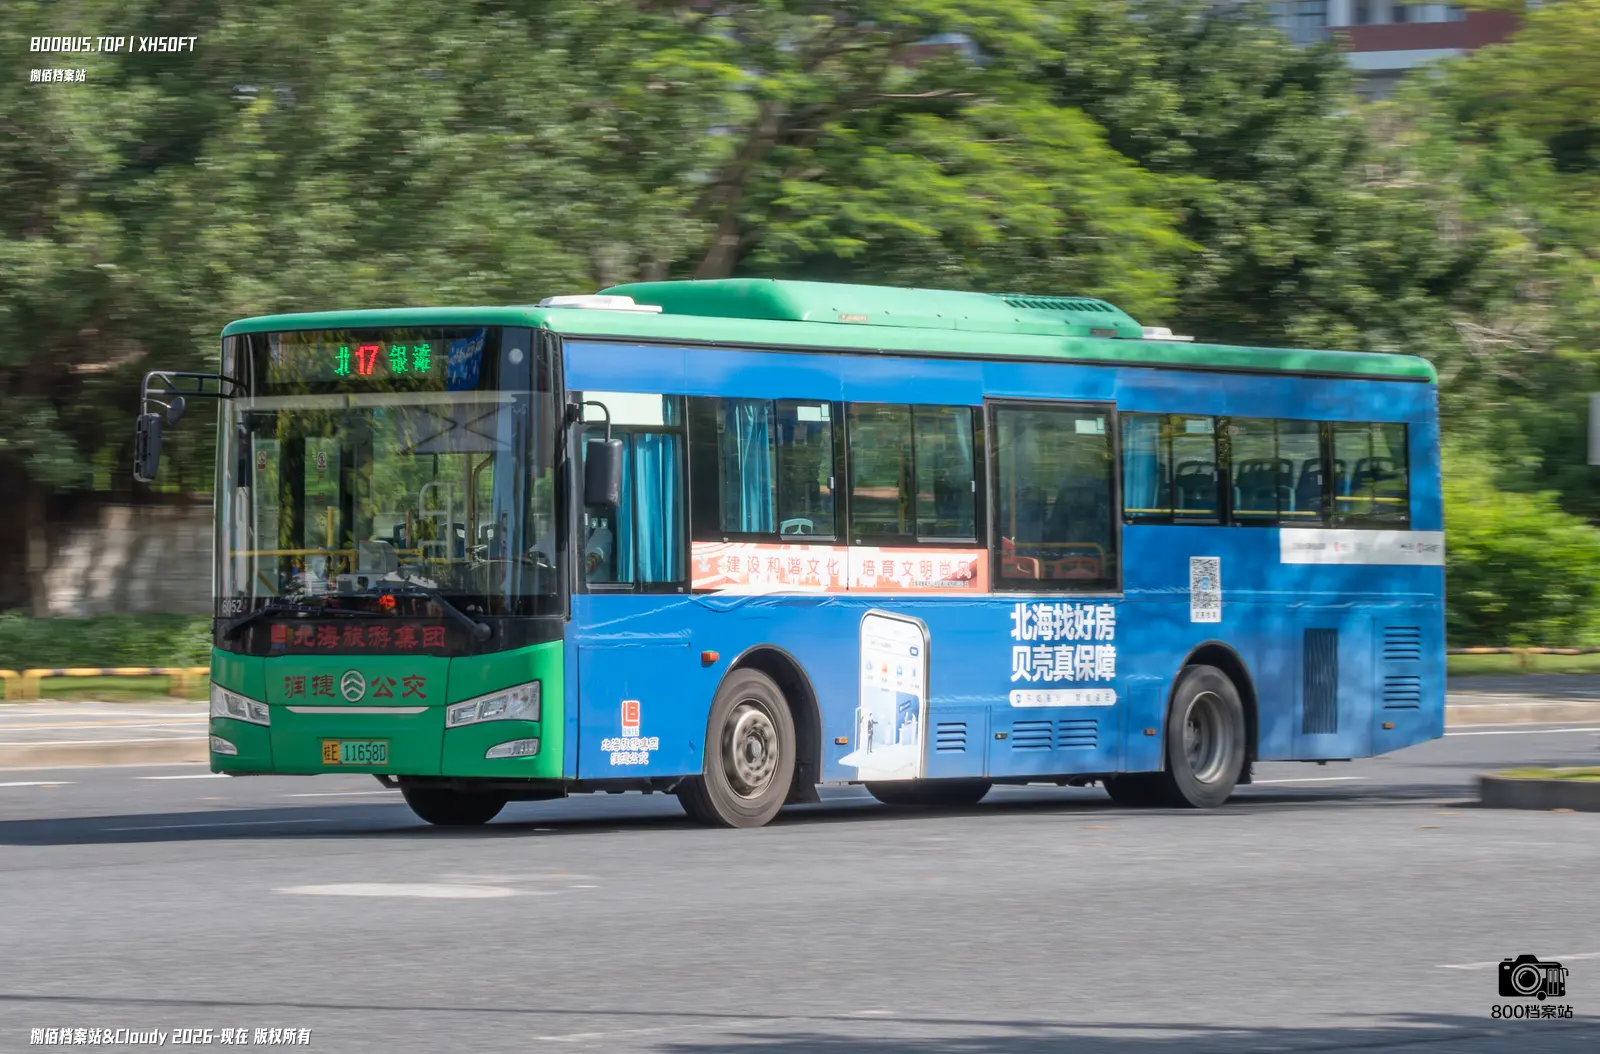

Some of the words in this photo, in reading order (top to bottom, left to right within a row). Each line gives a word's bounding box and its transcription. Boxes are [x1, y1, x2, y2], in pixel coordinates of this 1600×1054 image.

[355, 344, 379, 375] 17
[726, 555, 840, 576] 建设和谐文化
[1010, 603, 1117, 641] 北海找好房
[293, 624, 446, 649] 北海旅游集团
[1010, 643, 1117, 682] 贝壳真保障
[284, 674, 336, 699] 润捷
[371, 674, 428, 699] 公交
